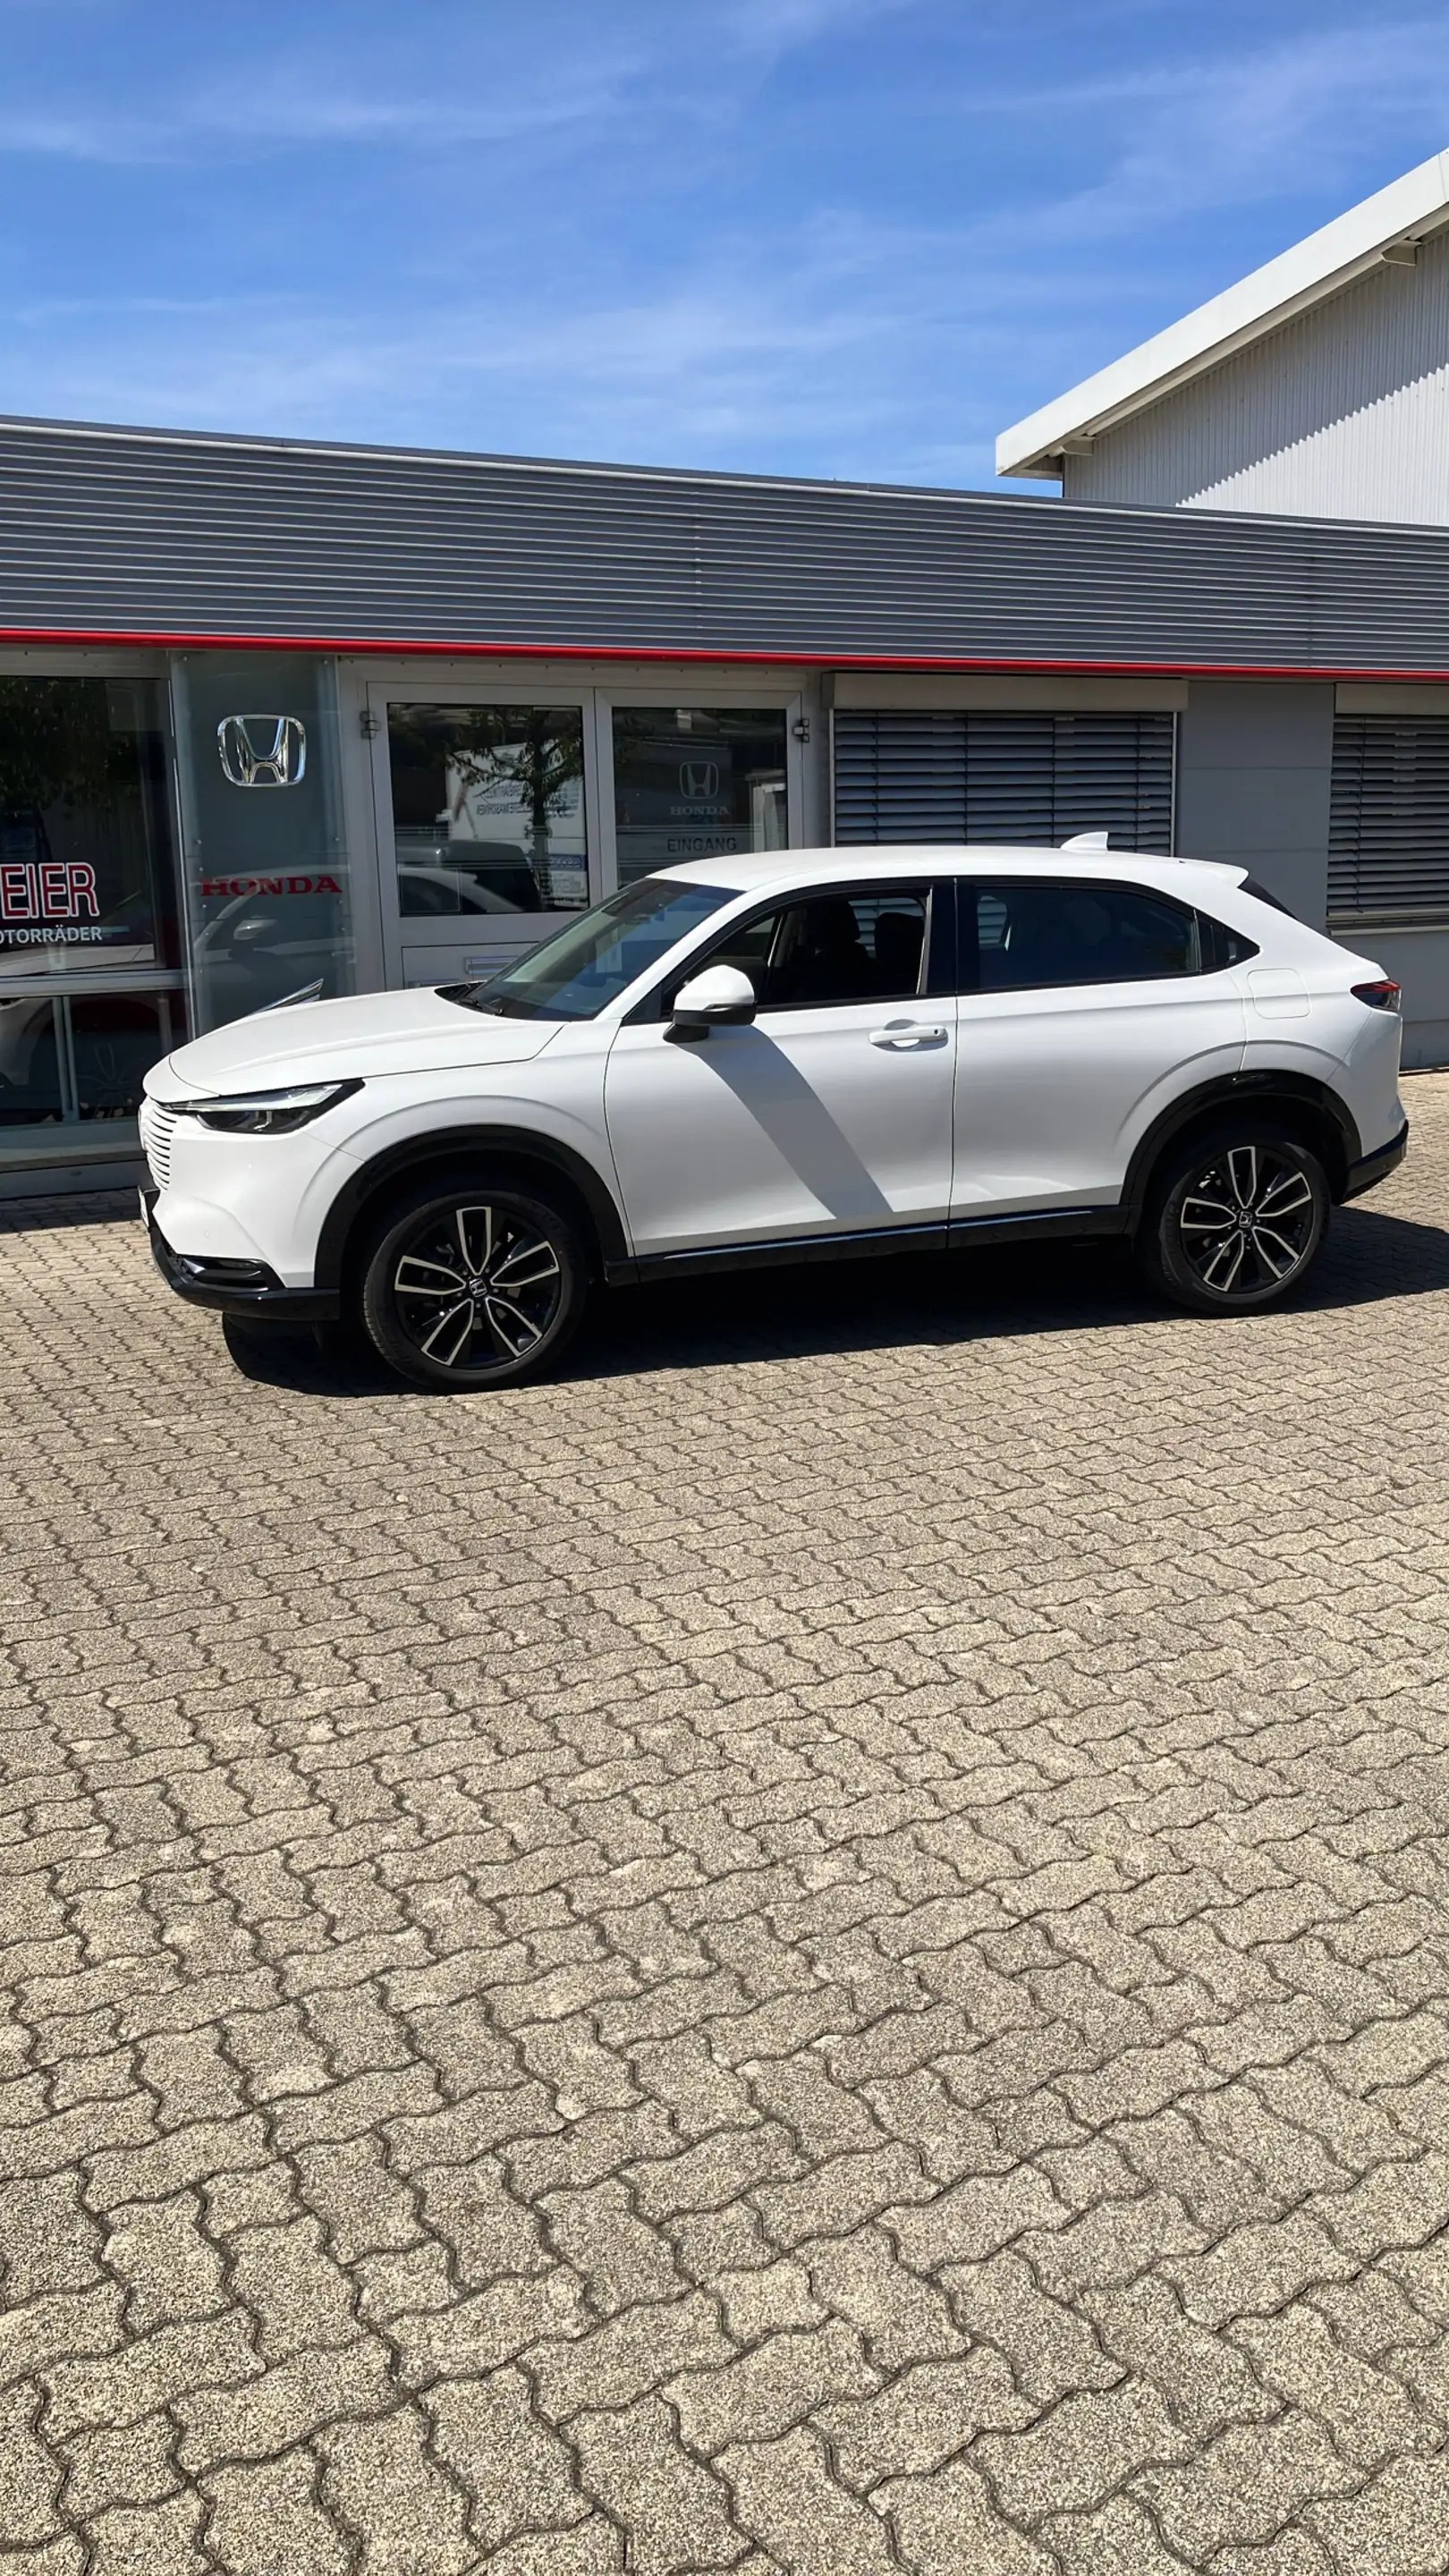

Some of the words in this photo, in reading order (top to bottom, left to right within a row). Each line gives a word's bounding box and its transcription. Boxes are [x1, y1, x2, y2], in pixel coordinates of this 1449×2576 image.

[670, 806, 731, 816] HONDA
[667, 837, 737, 852] EINGANG
[200, 876, 343, 897] HONDA
